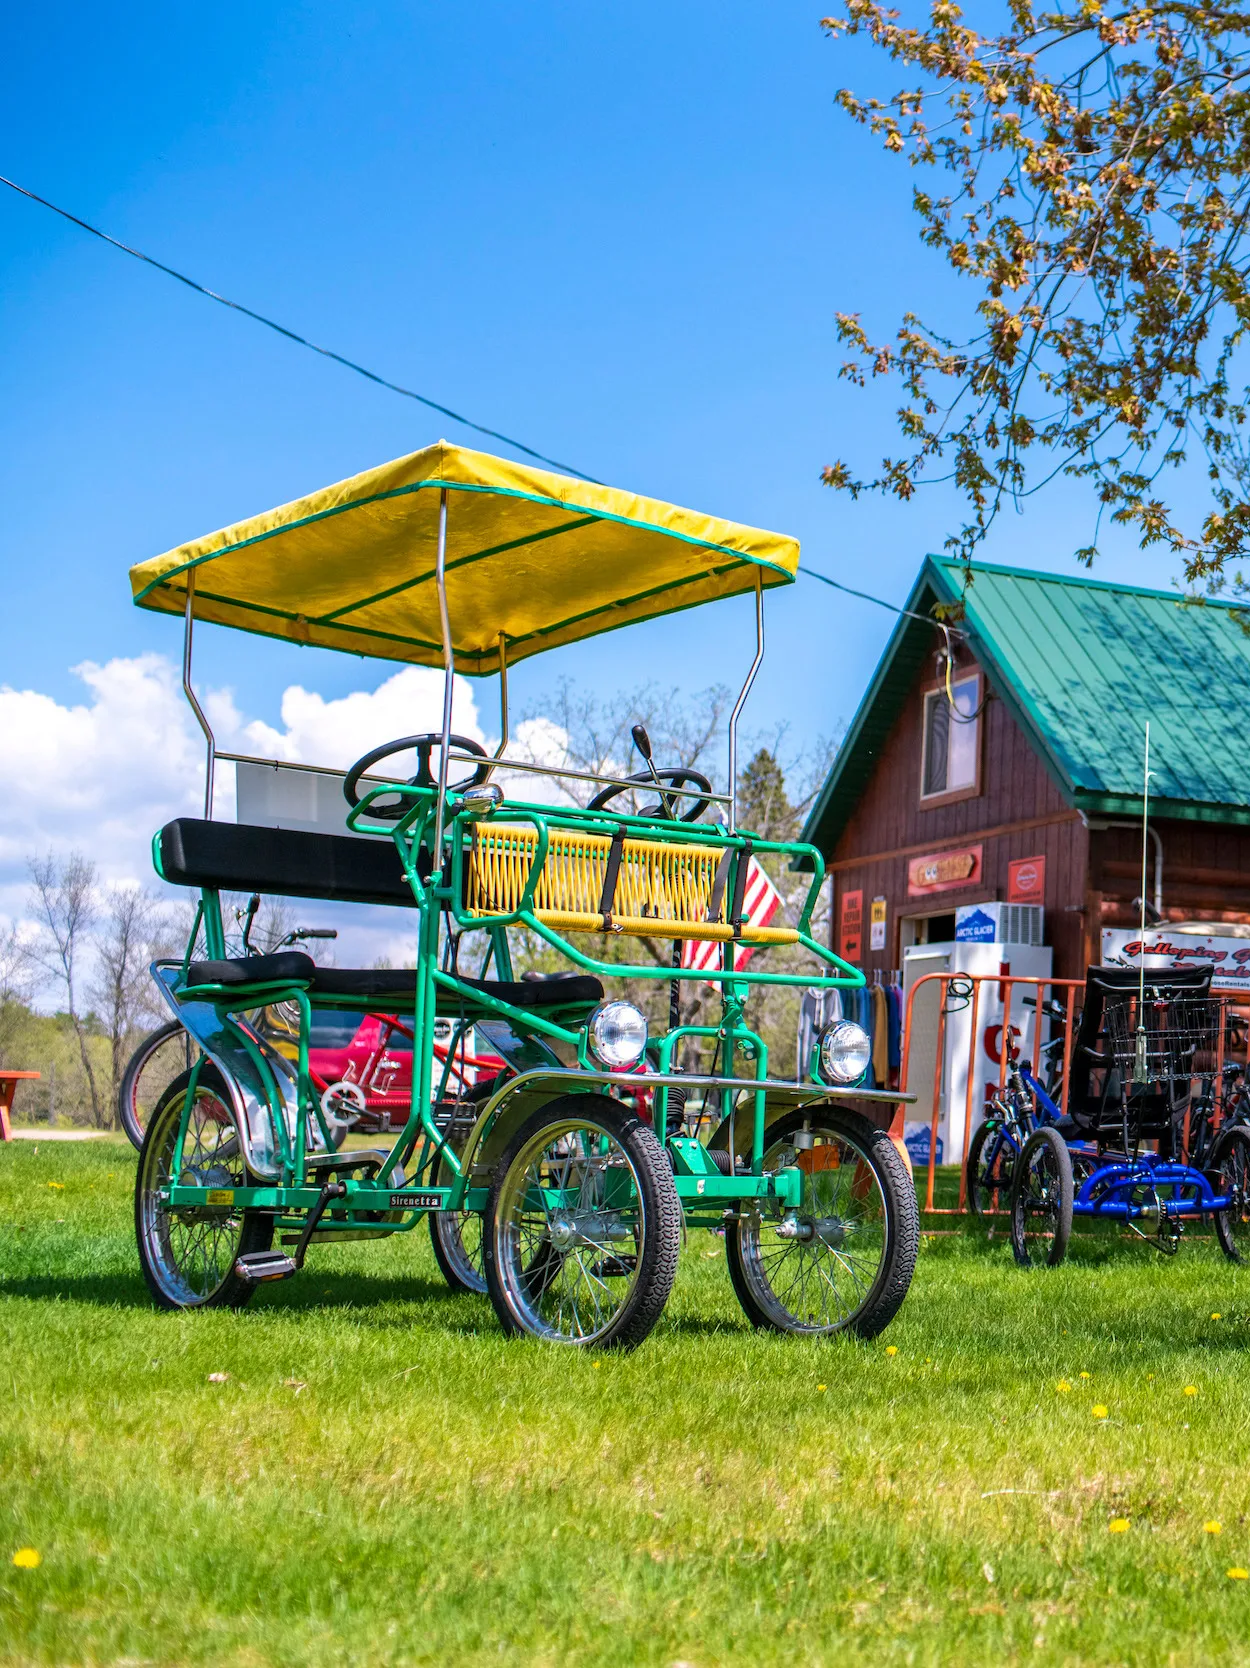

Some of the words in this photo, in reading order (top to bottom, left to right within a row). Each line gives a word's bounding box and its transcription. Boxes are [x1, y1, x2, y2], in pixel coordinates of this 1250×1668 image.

[957, 928, 974, 938] ARCTIC
[974, 925, 993, 936] GLACIER
[1122, 941, 1228, 963] Galloping
[391, 1196, 438, 1206] Sirenetta
